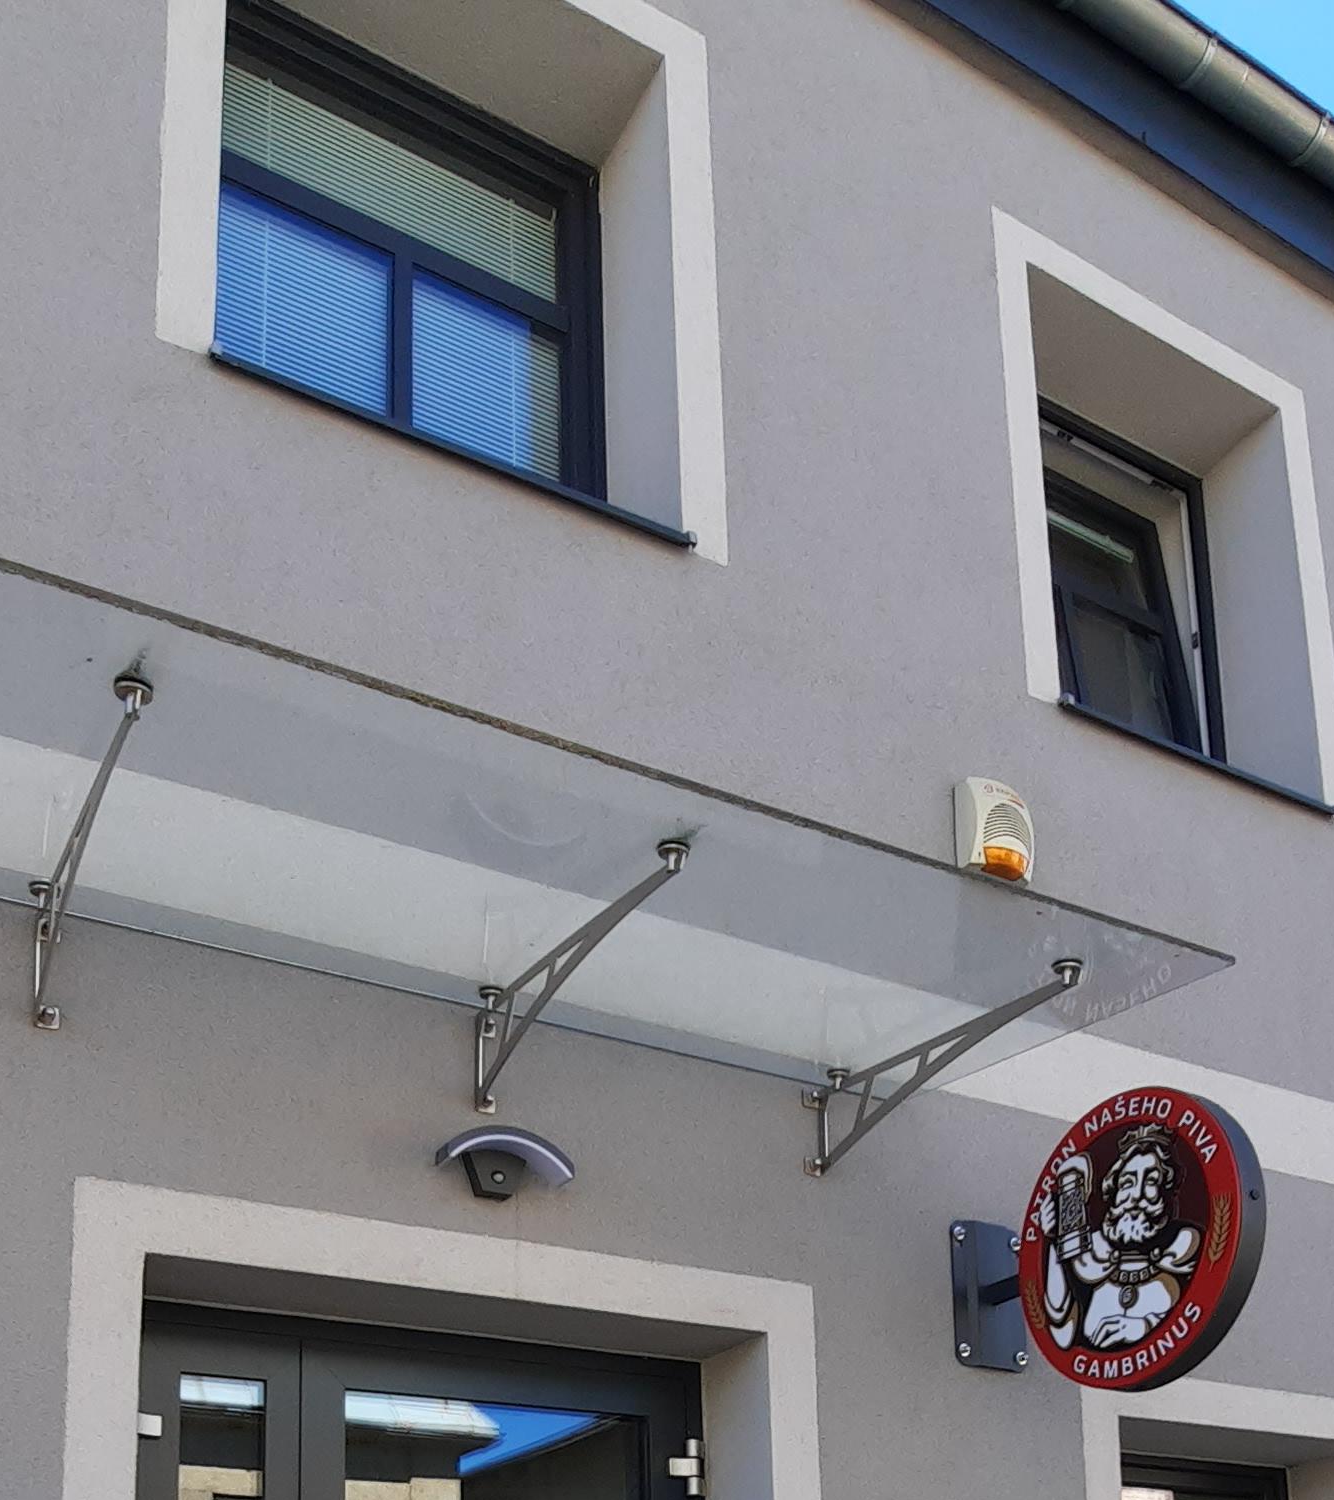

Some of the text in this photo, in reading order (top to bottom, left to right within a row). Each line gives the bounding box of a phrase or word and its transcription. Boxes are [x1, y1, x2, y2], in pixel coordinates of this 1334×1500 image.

[1026, 1095, 1218, 1242] PATRON NAŠEHO PIVA
[1073, 1301, 1202, 1379] GAMBRINUS
